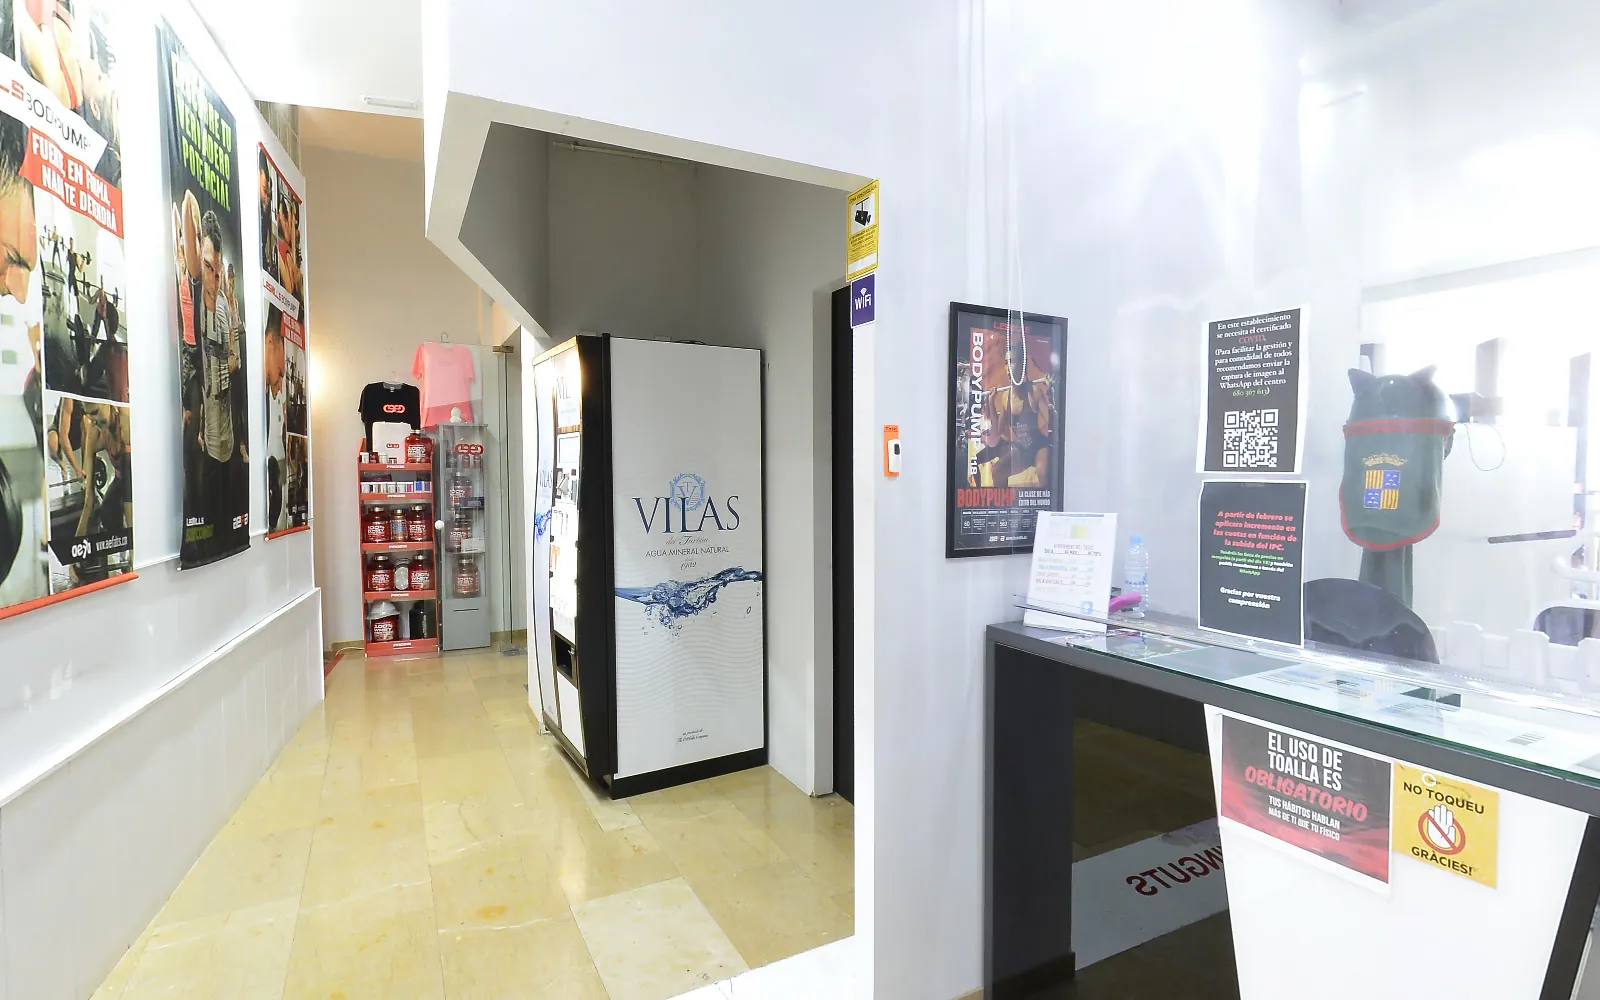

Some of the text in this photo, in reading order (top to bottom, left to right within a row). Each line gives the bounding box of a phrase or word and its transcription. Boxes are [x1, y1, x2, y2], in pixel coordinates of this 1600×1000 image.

[220, 117, 232, 153] TU
[67, 158, 83, 186] EN
[181, 135, 231, 212] POTENCIAL
[1240, 314, 1291, 327] establecimiento
[1224, 328, 1249, 338] necesita
[1256, 322, 1292, 333] certificado
[1214, 341, 1293, 356] (Para facilitar la gestión y
[1214, 350, 1293, 366] para comodidad de todos
[1216, 358, 1291, 373] recomendamos enviar la
[1219, 377, 1287, 390] WhatsApp del centro
[1220, 373, 1243, 382] captura
[1243, 371, 1252, 379] de
[1253, 369, 1277, 379] imagen
[970, 332, 984, 450] BODYPUMP
[957, 488, 1016, 508] BODYPUMP
[632, 495, 740, 534] VILAS
[1224, 511, 1245, 519] partir
[1256, 512, 1283, 521] febrero
[1243, 521, 1284, 531] incremento
[1232, 539, 1255, 548] subida
[1255, 542, 1268, 550] del
[1269, 543, 1285, 551] IPC.
[1257, 532, 1286, 541] función
[1286, 534, 1297, 542] de
[645, 546, 730, 558] AGUA MINERAL NATURAL
[1219, 587, 1281, 601] Gracias por vuestra
[1228, 597, 1271, 609] comprensión
[1268, 731, 1343, 772] EL USO DE
[1267, 750, 1342, 791] TOALLA ES
[1245, 765, 1368, 822] OBLIGATORIO
[1403, 781, 1485, 815] NO TOQUEU
[1268, 795, 1341, 830] TUS HÁBITOS HABLAN
[1268, 806, 1340, 841] MÁS DE TI QUE TU FÍSICO
[1411, 846, 1473, 876] GRÀCIES!
